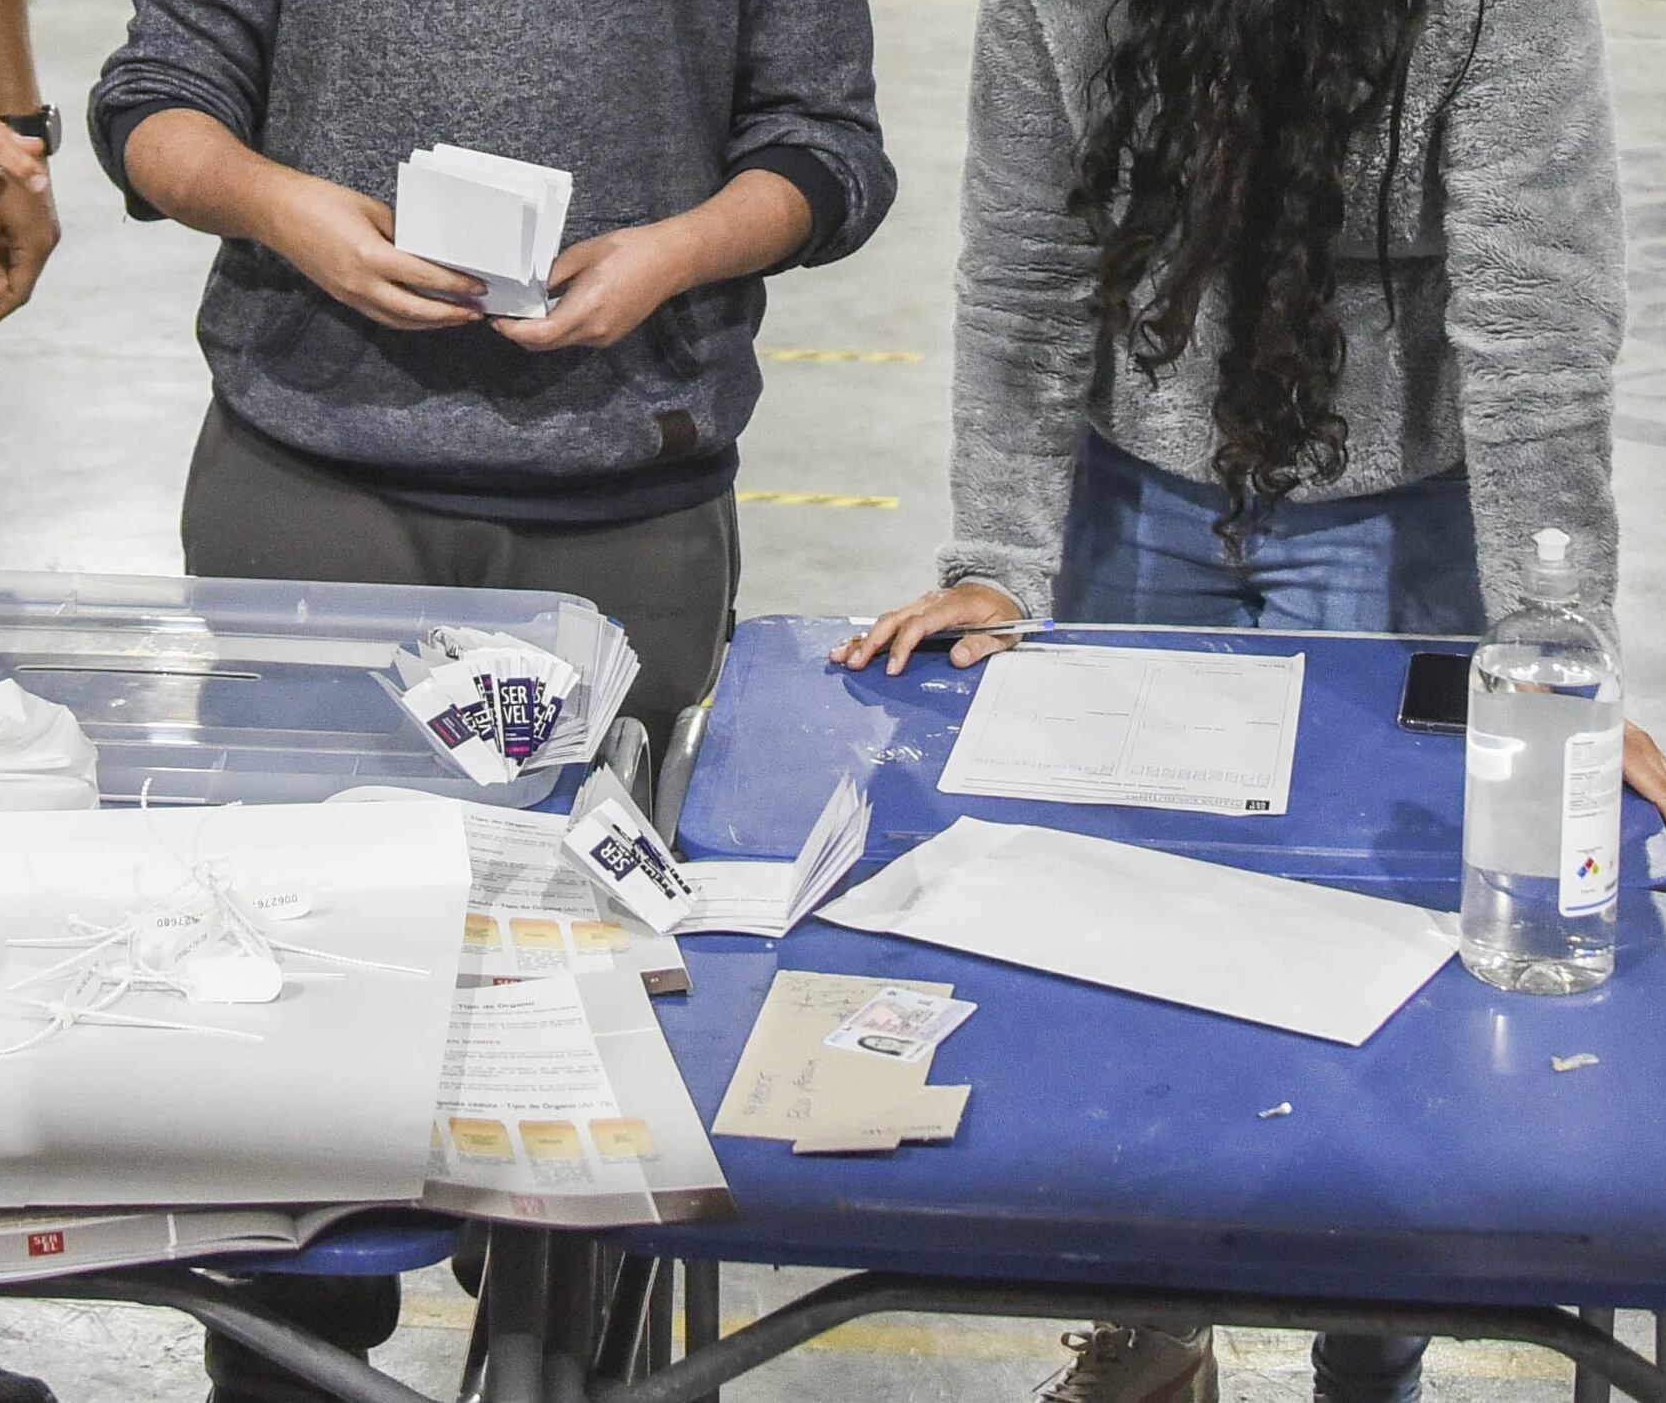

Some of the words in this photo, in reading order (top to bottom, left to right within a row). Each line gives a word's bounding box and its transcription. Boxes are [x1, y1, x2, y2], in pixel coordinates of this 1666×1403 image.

[500, 685, 529, 705] SER
[502, 705, 531, 725] VEL
[600, 841, 631, 872] SER
